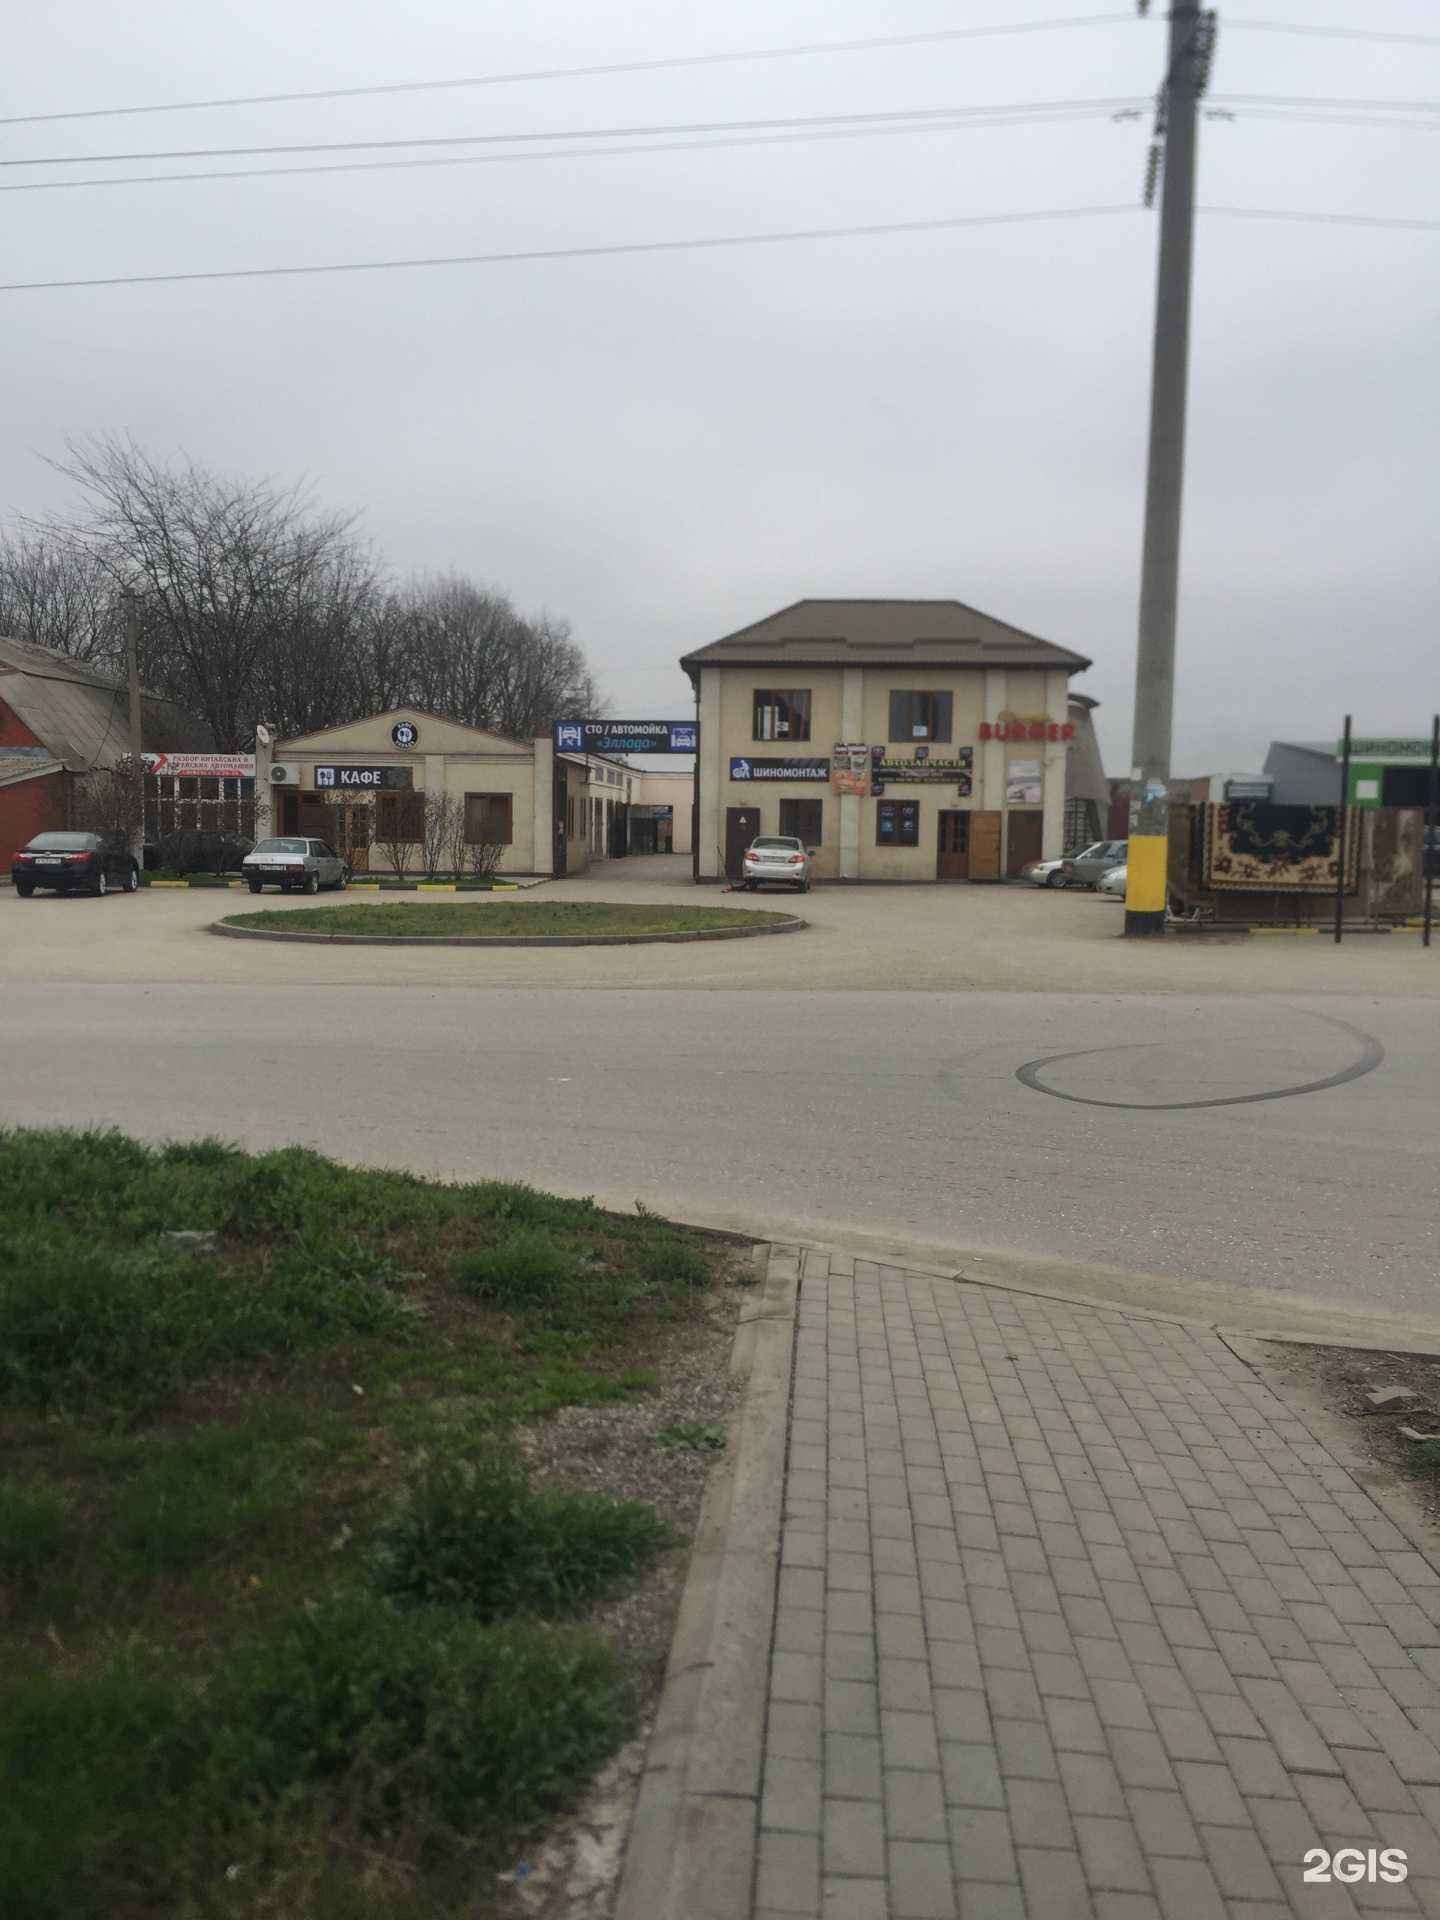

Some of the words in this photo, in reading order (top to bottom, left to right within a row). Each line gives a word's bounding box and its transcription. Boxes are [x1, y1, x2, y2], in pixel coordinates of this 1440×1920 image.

[585, 724, 601, 735] СТО
[611, 723, 668, 735] АВТОМОЙКА
[341, 770, 382, 784] КАФЕ
[753, 767, 827, 778] ШИНОМОНТАЖ
